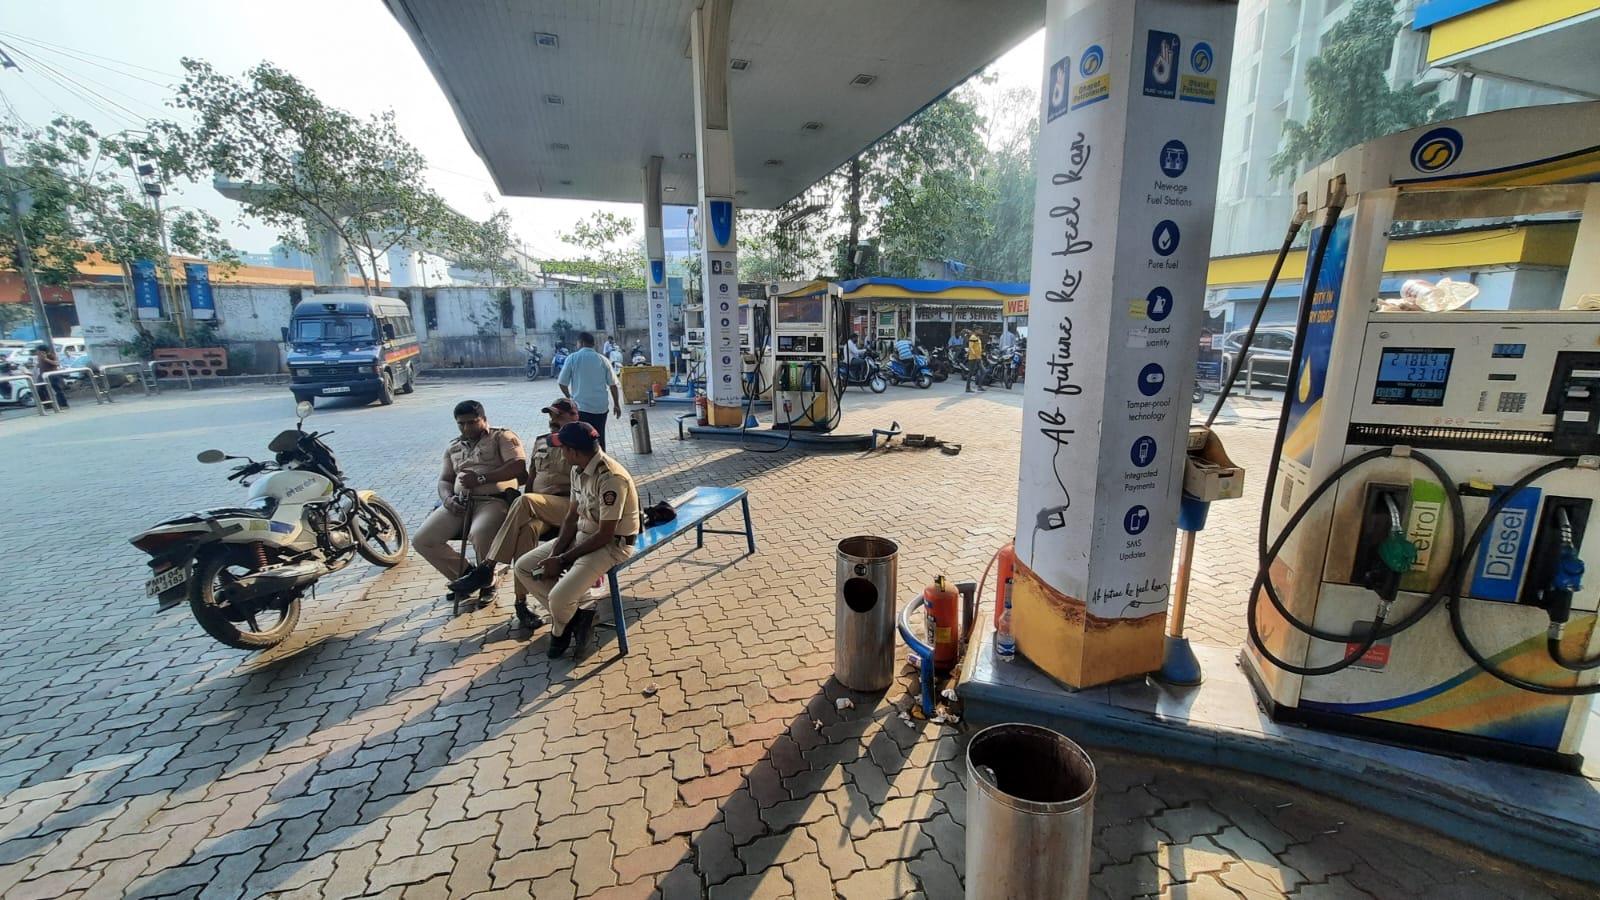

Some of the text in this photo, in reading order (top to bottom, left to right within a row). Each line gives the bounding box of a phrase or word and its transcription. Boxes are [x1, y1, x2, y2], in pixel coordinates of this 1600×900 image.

[1052, 132, 1091, 186] kar
[1154, 181, 1188, 194] New-age
[1147, 194, 1192, 207] Fuel Stations
[1049, 197, 1093, 256] feel
[1148, 258, 1179, 269] Pure fuel
[1045, 269, 1082, 303] ko
[969, 310, 998, 321] SERVICE
[1146, 339, 1170, 348] uantity
[1043, 316, 1082, 395] future
[1127, 398, 1171, 410] Tamper-proof
[1128, 411, 1166, 421] technology
[1038, 407, 1075, 445] Ab
[1124, 470, 1158, 480] Integrated
[1124, 481, 1156, 493] Payments
[1126, 539, 1143, 549] SMS
[1485, 509, 1525, 577] Diesel
[1119, 551, 1146, 561] Updates
